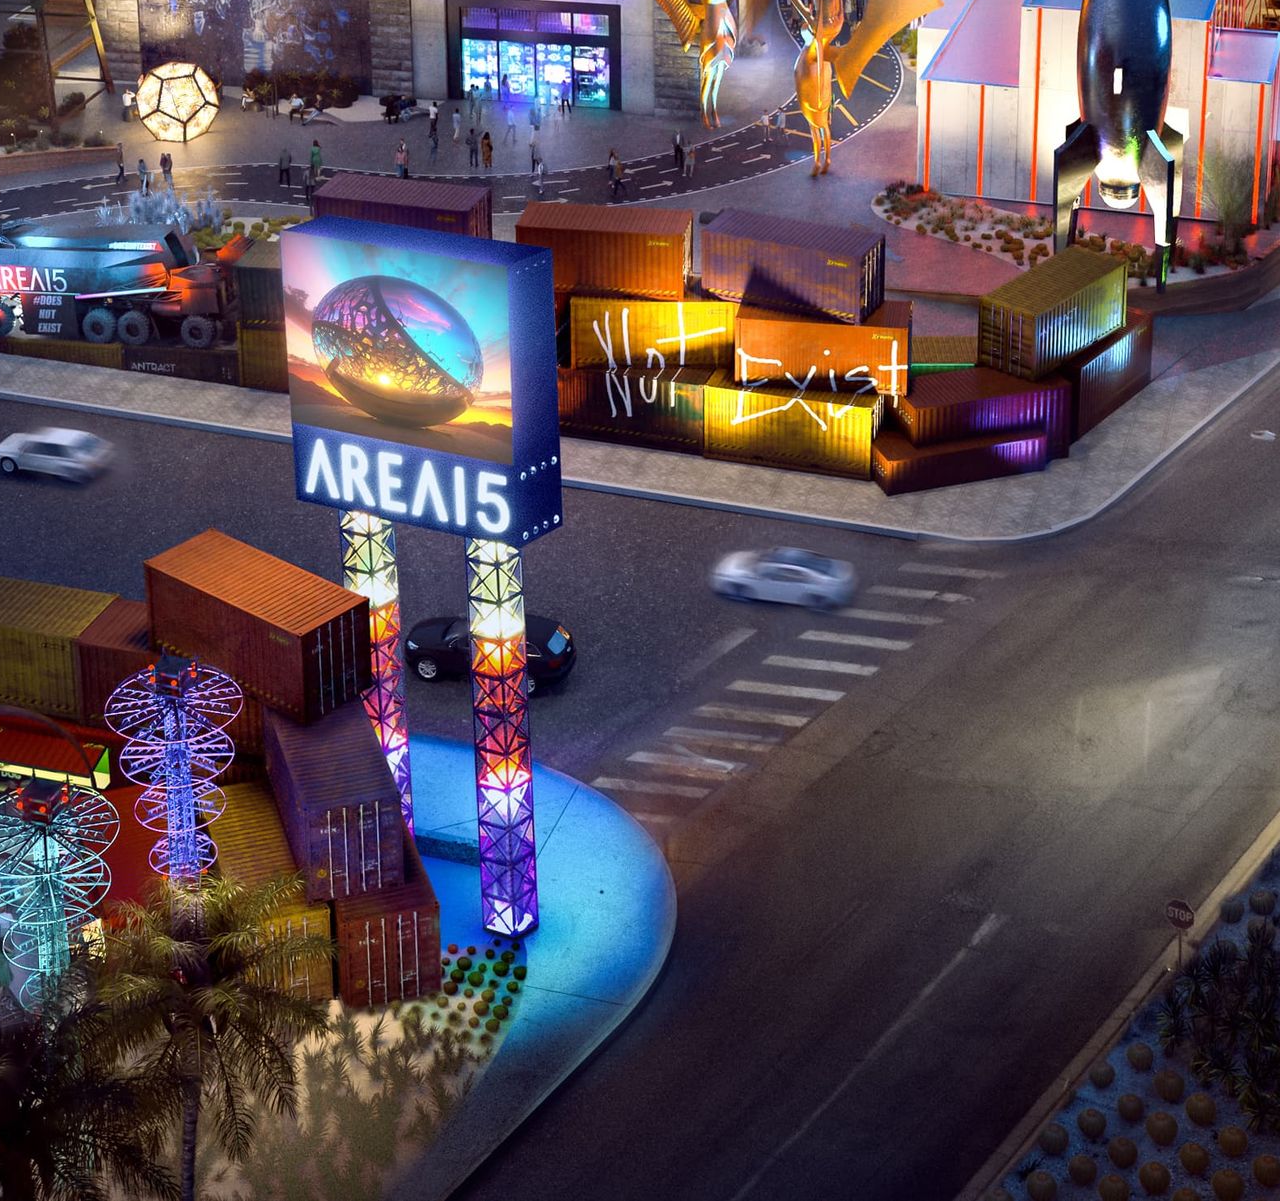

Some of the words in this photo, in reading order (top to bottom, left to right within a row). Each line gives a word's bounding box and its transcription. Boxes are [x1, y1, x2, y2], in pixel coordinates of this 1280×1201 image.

[33, 295, 63, 307] #DOES
[38, 309, 57, 320] NOT
[37, 322, 63, 334] EXIST
[305, 437, 511, 534] AREA15
